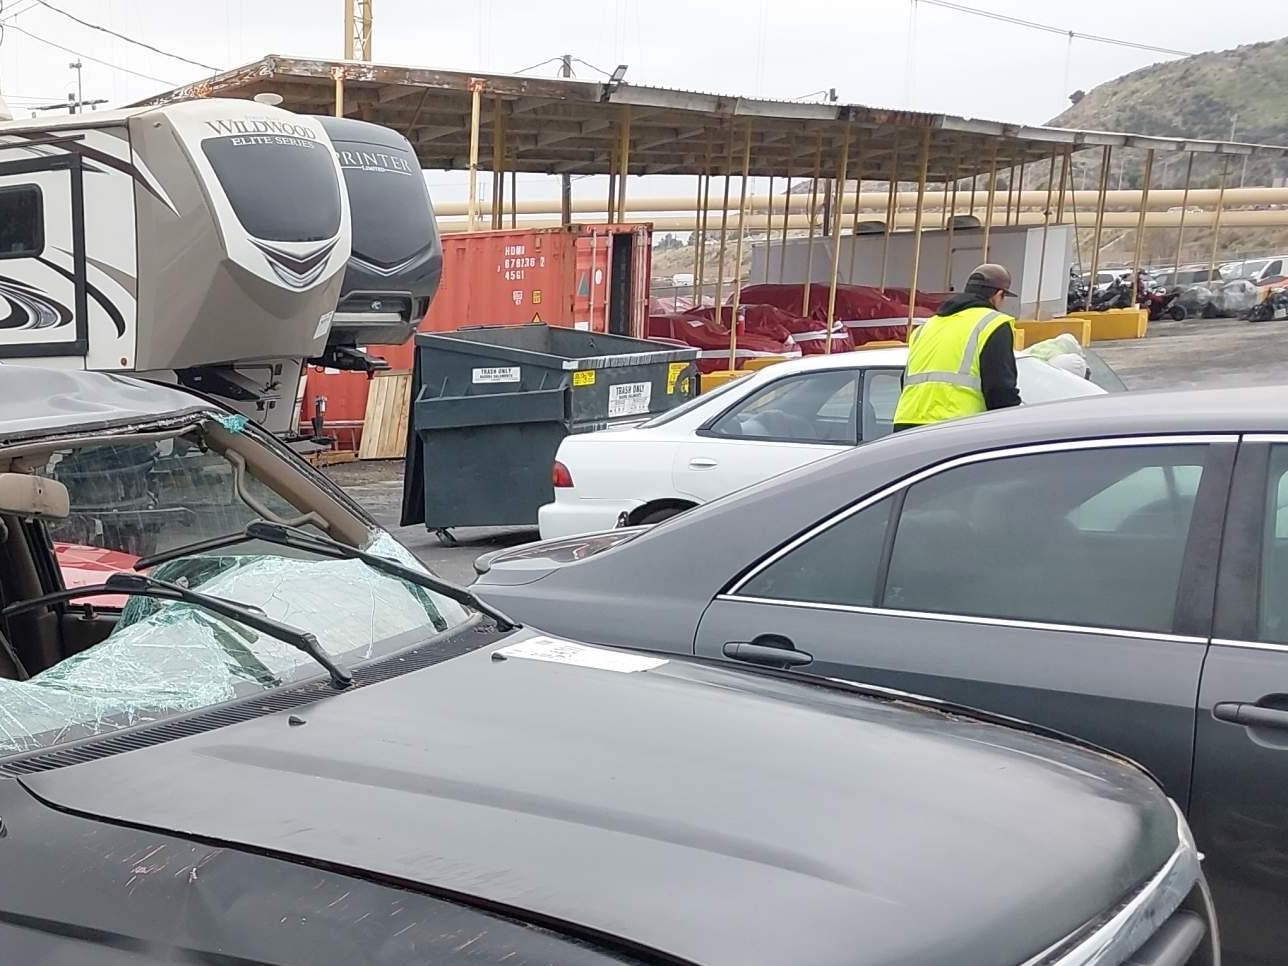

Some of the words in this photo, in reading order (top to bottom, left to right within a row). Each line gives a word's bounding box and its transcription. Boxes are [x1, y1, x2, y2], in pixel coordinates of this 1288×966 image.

[206, 119, 316, 139] WILDWOOD
[232, 136, 273, 146] ELITE
[275, 136, 314, 149] SERIES
[334, 151, 412, 172] PRINTER
[616, 386, 632, 395] TRASH
[633, 385, 645, 393] ONLY
